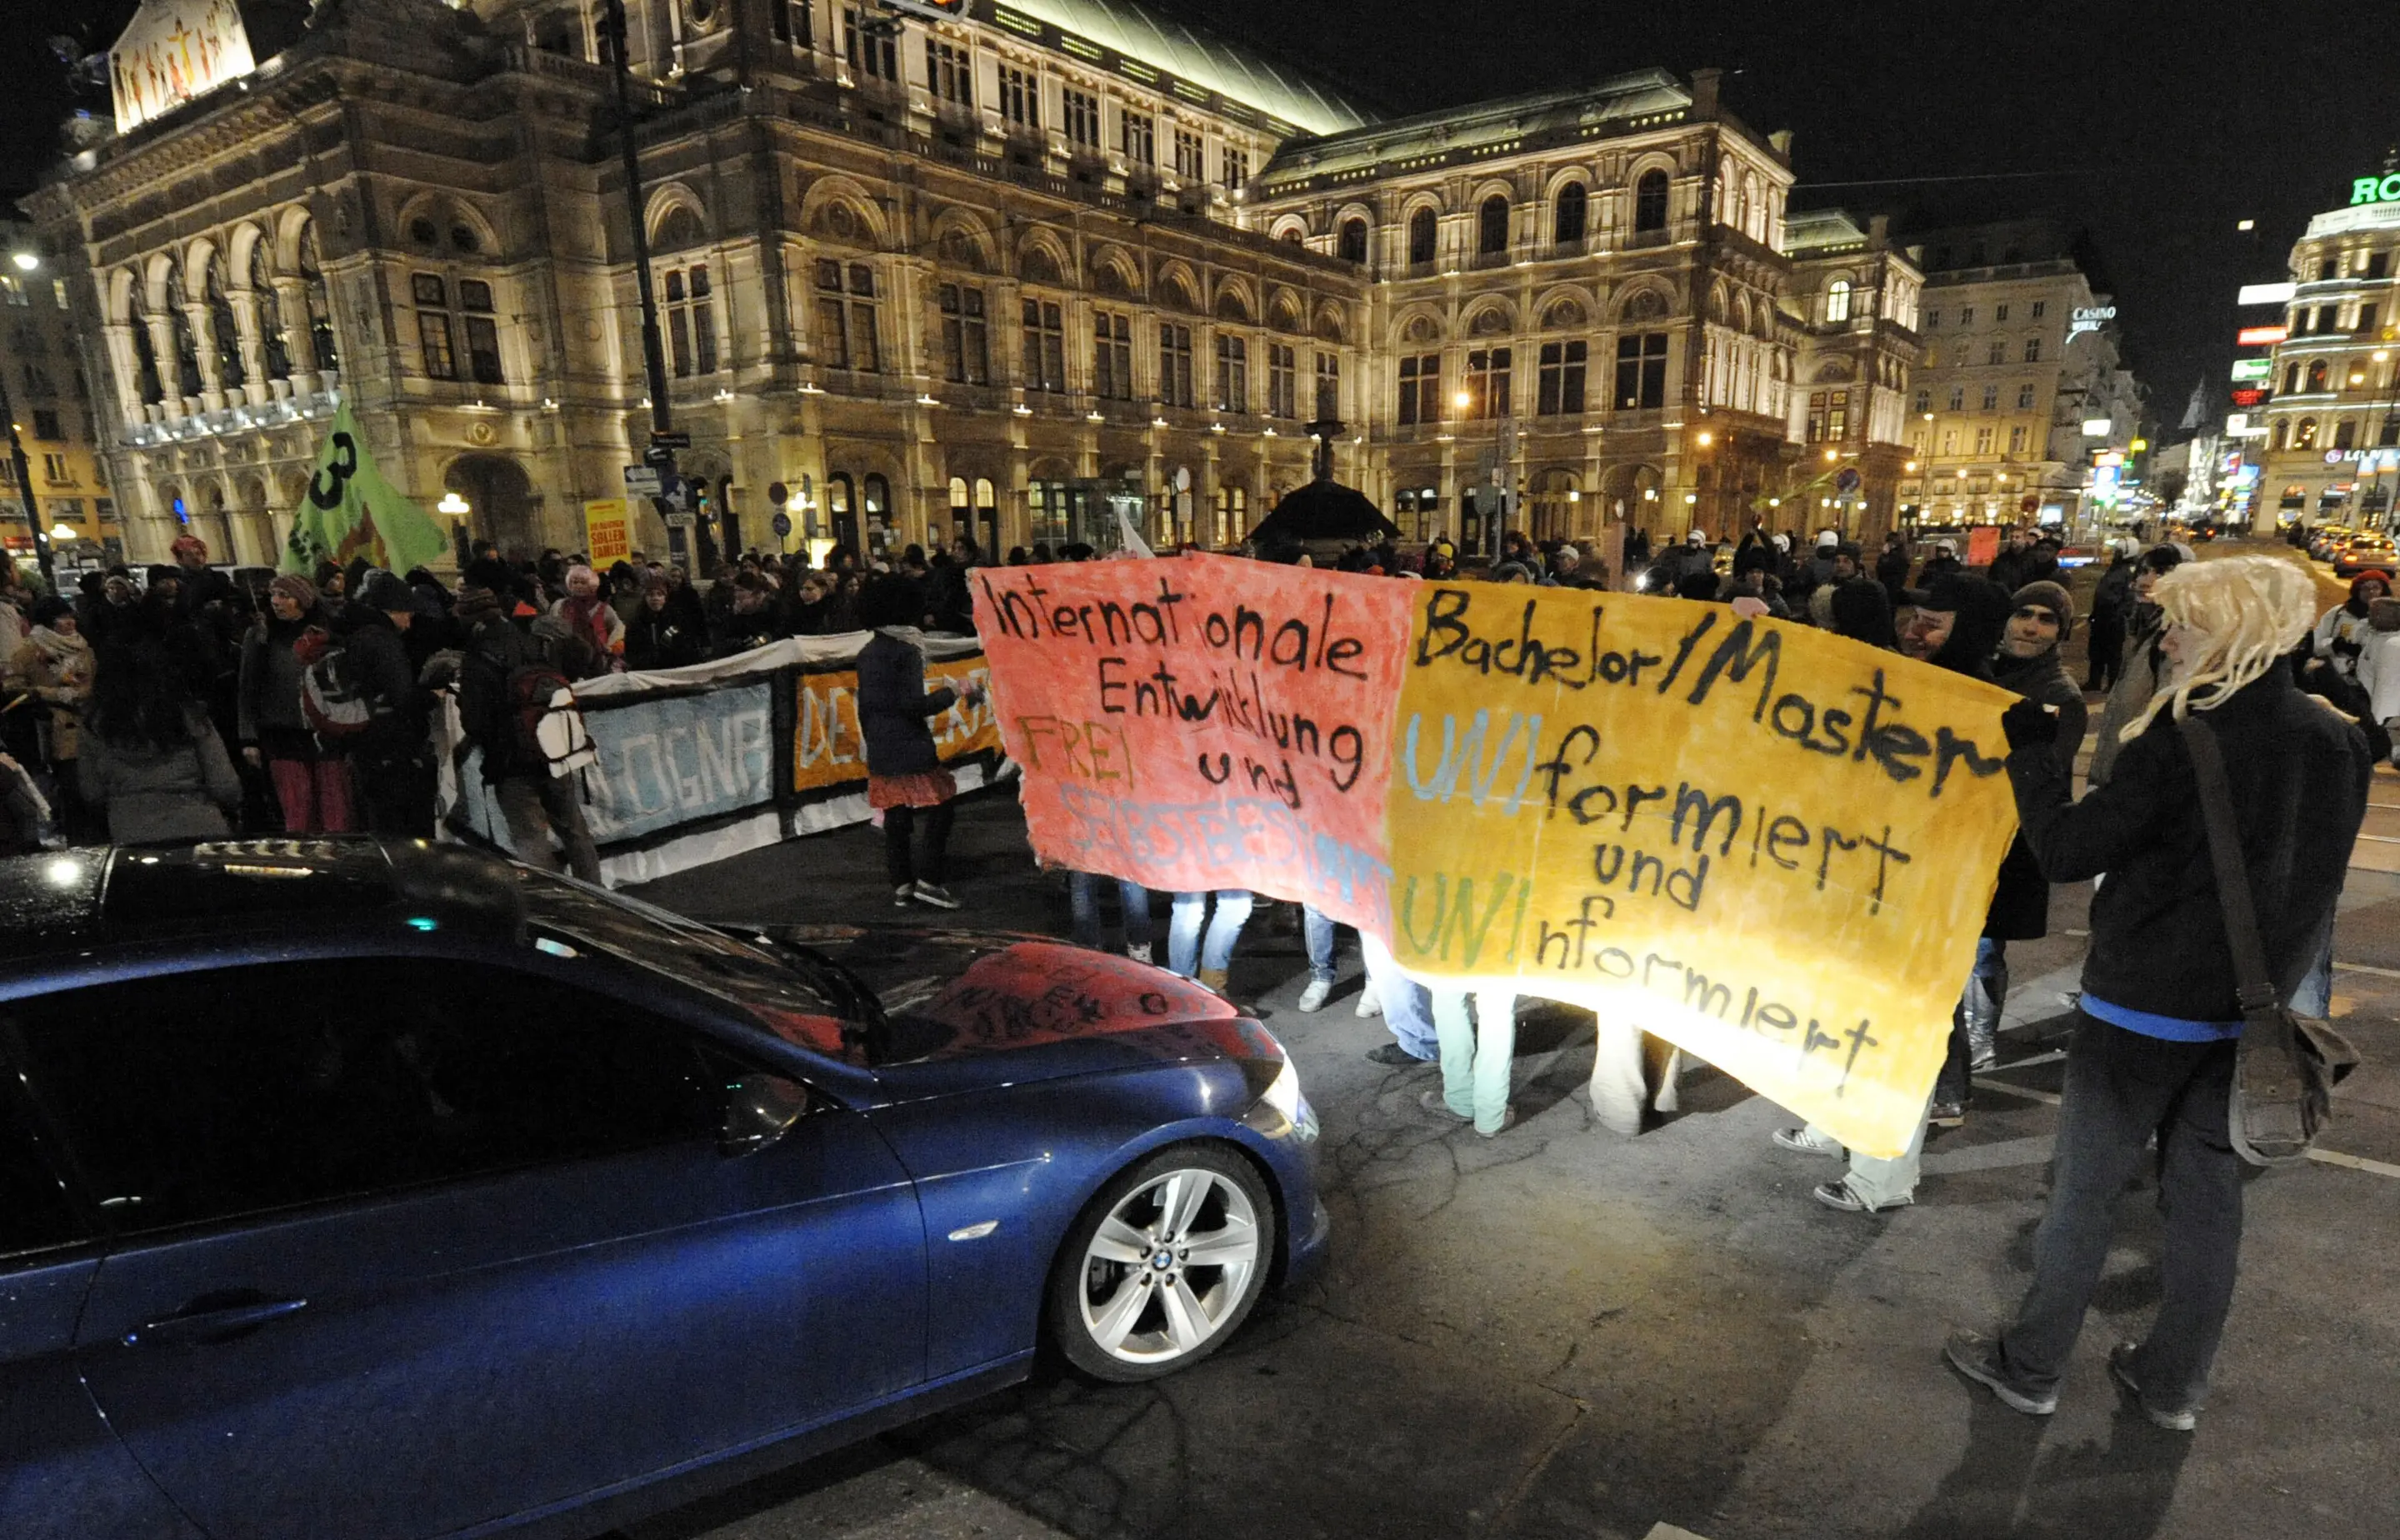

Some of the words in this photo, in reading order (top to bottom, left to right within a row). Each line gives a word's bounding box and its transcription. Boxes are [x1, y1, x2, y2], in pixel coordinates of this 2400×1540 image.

[2072, 306, 2117, 321] CASINO
[982, 572, 1368, 681] Internationale
[1416, 589, 2007, 798] Bachelor/Master
[1016, 715, 1134, 790] FREI
[1198, 752, 1301, 809] und
[1593, 842, 1709, 912] und
